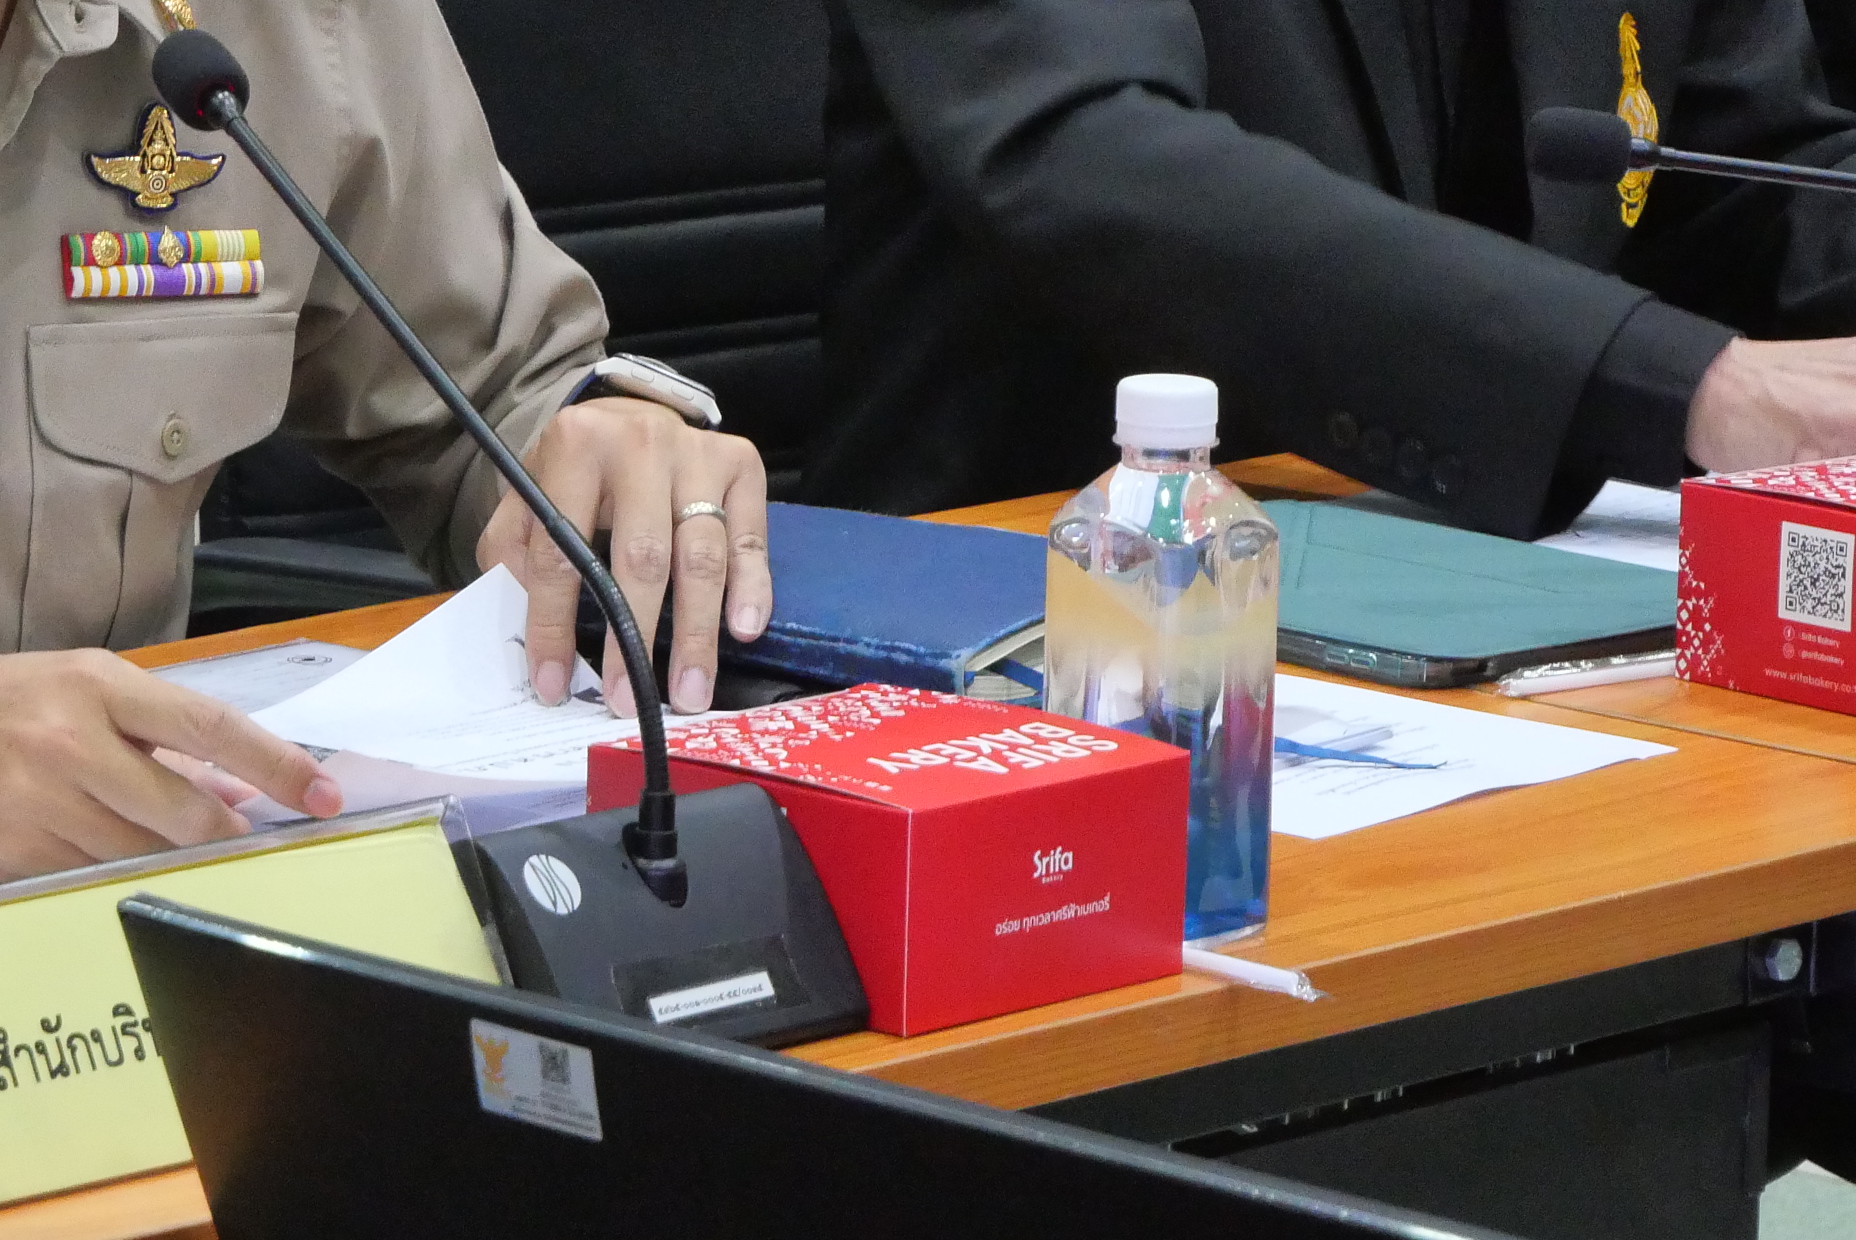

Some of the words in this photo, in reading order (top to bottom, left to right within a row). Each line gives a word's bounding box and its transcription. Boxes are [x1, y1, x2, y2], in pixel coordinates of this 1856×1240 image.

[866, 721, 1076, 774] BAKERY
[953, 734, 1119, 774] SRIFA
[1032, 845, 1074, 879] Srifa
[995, 918, 1021, 936] อร่อย
